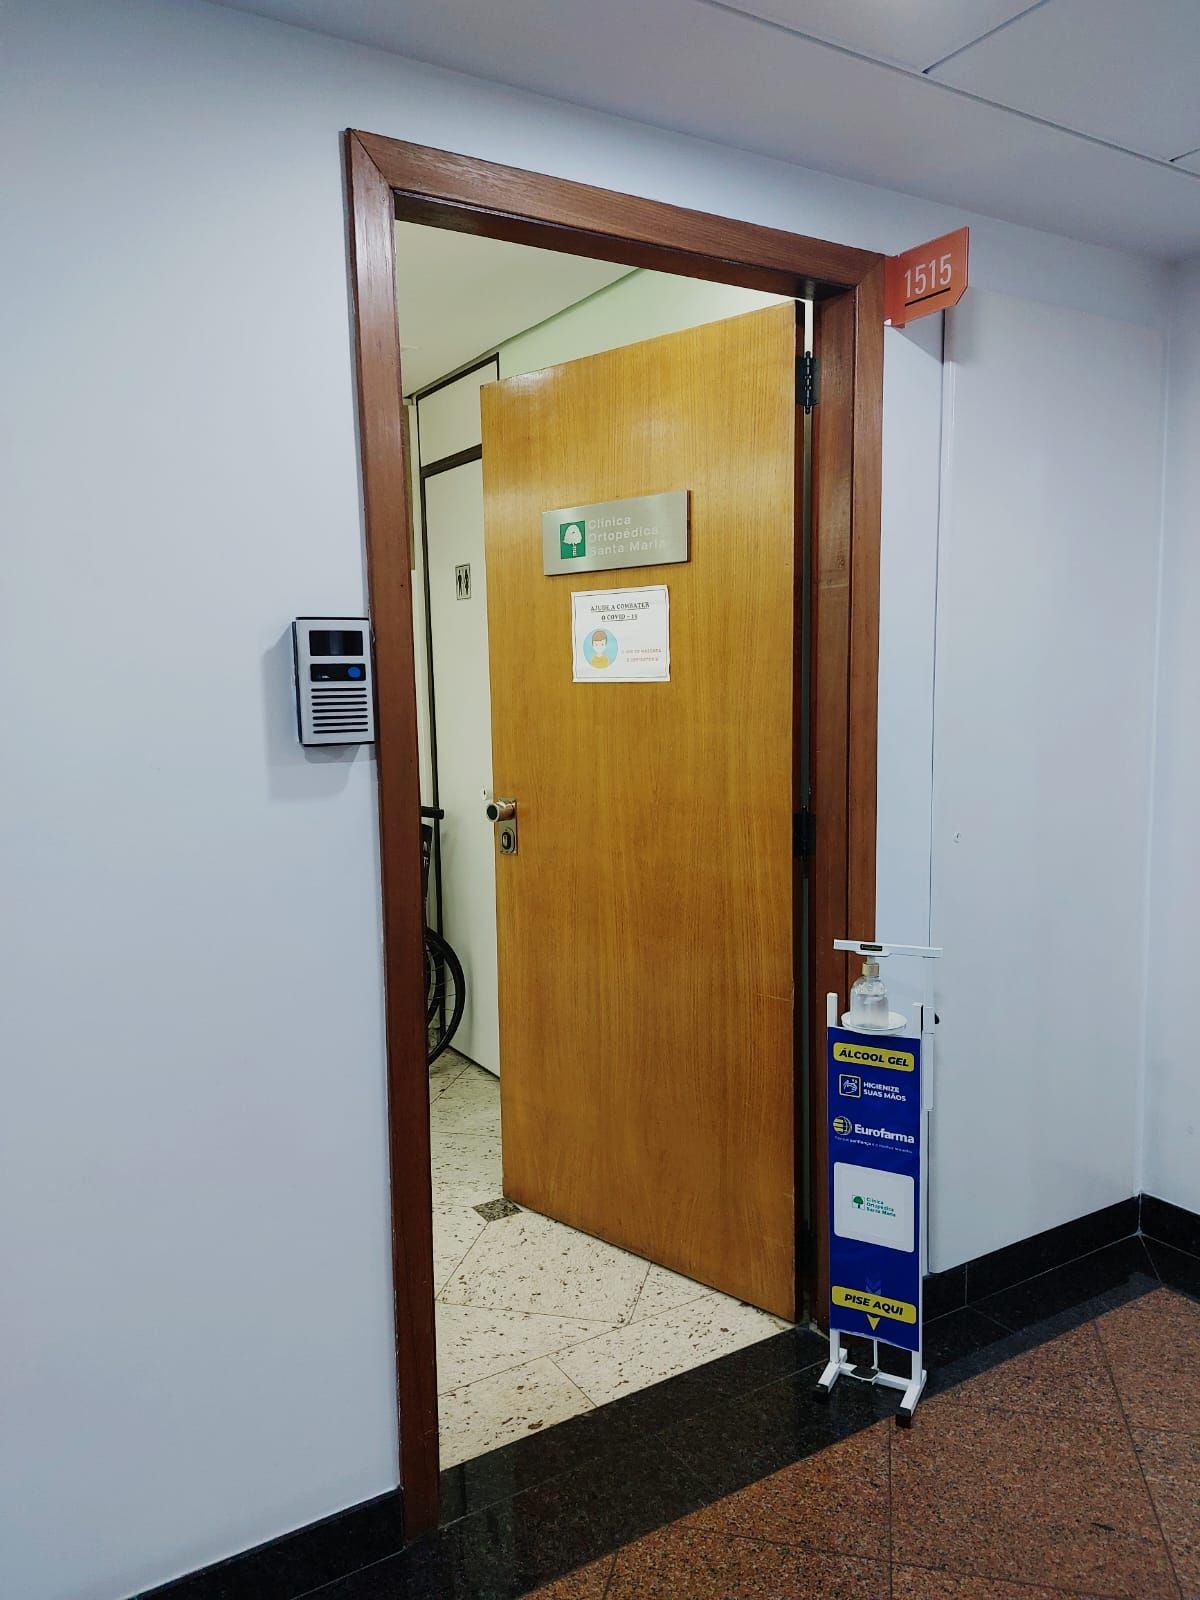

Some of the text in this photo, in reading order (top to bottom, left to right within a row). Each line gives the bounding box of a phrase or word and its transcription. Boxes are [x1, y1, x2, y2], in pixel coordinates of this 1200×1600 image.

[904, 253, 951, 298] 1515
[590, 544, 625, 556] Santa
[839, 1047, 909, 1067] ÁLCOOL GEL
[863, 1081, 900, 1094] HIGIENIZE
[863, 1088, 907, 1102] SUAS MÃOS
[855, 1123, 915, 1144] Eurofarma
[844, 1293, 904, 1316] PISE AQUI
